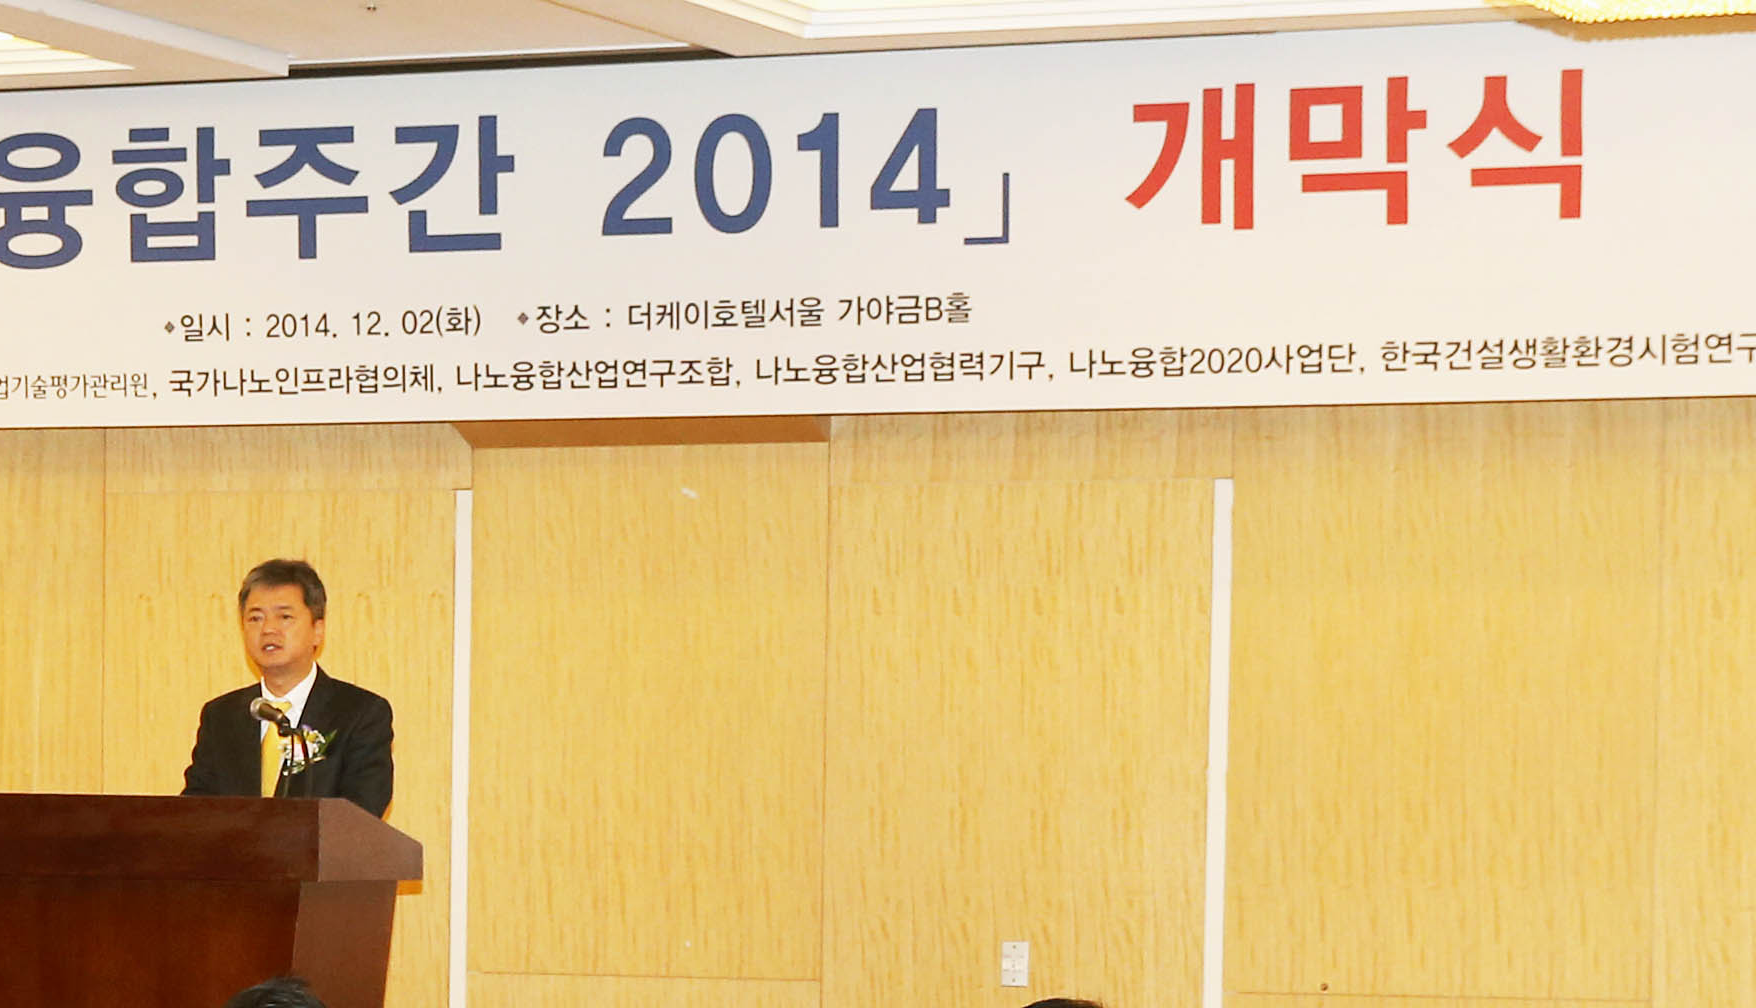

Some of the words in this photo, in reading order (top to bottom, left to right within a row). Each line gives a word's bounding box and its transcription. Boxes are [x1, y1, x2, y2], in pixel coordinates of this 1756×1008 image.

[1124, 68, 1585, 231] 개막식
[180, 312, 231, 341] 일시
[265, 312, 338, 339] 2014.
[352, 310, 391, 336] 12.
[401, 305, 481, 337] 02(화)
[535, 303, 590, 334] 장소
[628, 297, 825, 330] 더케이호텔서울
[837, 293, 972, 326] 가야금B홀
[168, 364, 442, 398] 국가나노인프라협의체,
[455, 358, 741, 392] 나노융합산업연구조합,
[756, 350, 1054, 386] 나노융합산업협력기구,
[1069, 343, 1365, 380] 나노융합2020사업단,
